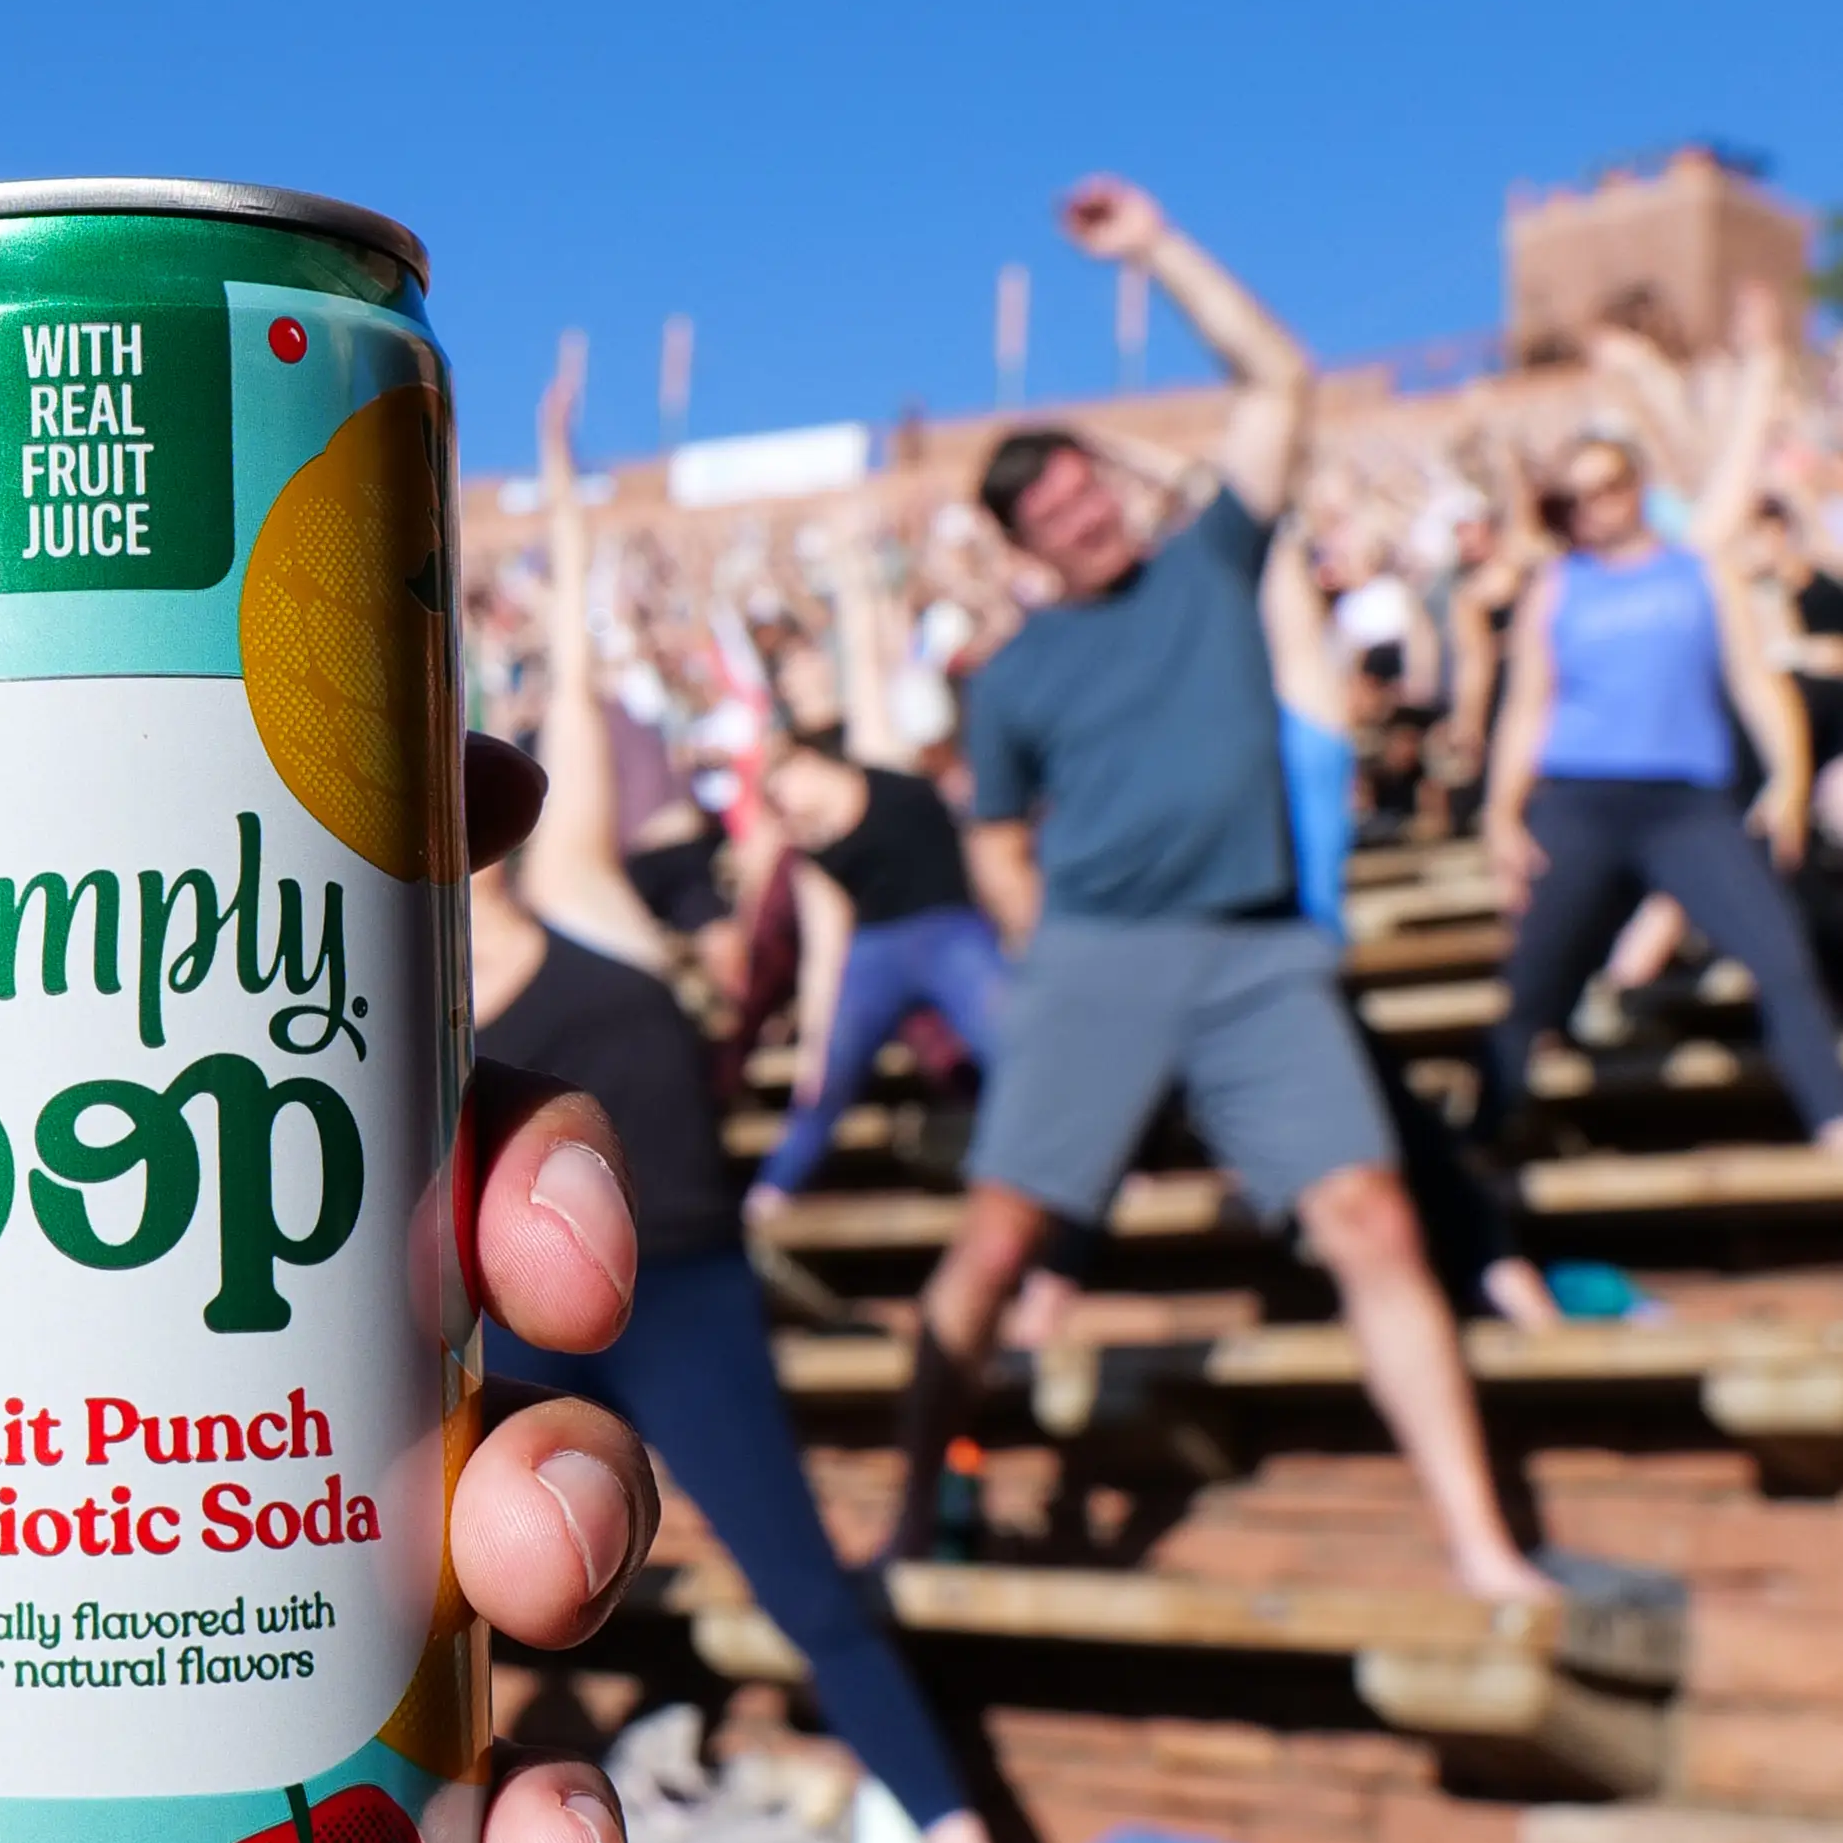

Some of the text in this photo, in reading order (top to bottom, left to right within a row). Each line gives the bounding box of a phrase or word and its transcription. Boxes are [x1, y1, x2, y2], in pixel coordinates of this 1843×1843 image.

[22, 322, 142, 378] WITH
[30, 383, 145, 437] REAL
[22, 443, 154, 498] FRUIT
[22, 503, 151, 559] JUICE
[84, 1387, 333, 1465] Punch
[201, 1474, 382, 1552] Soda
[72, 1597, 245, 1640] flavored
[256, 1591, 336, 1633] with
[14, 1648, 167, 1688] natural
[176, 1646, 315, 1687] flavors
